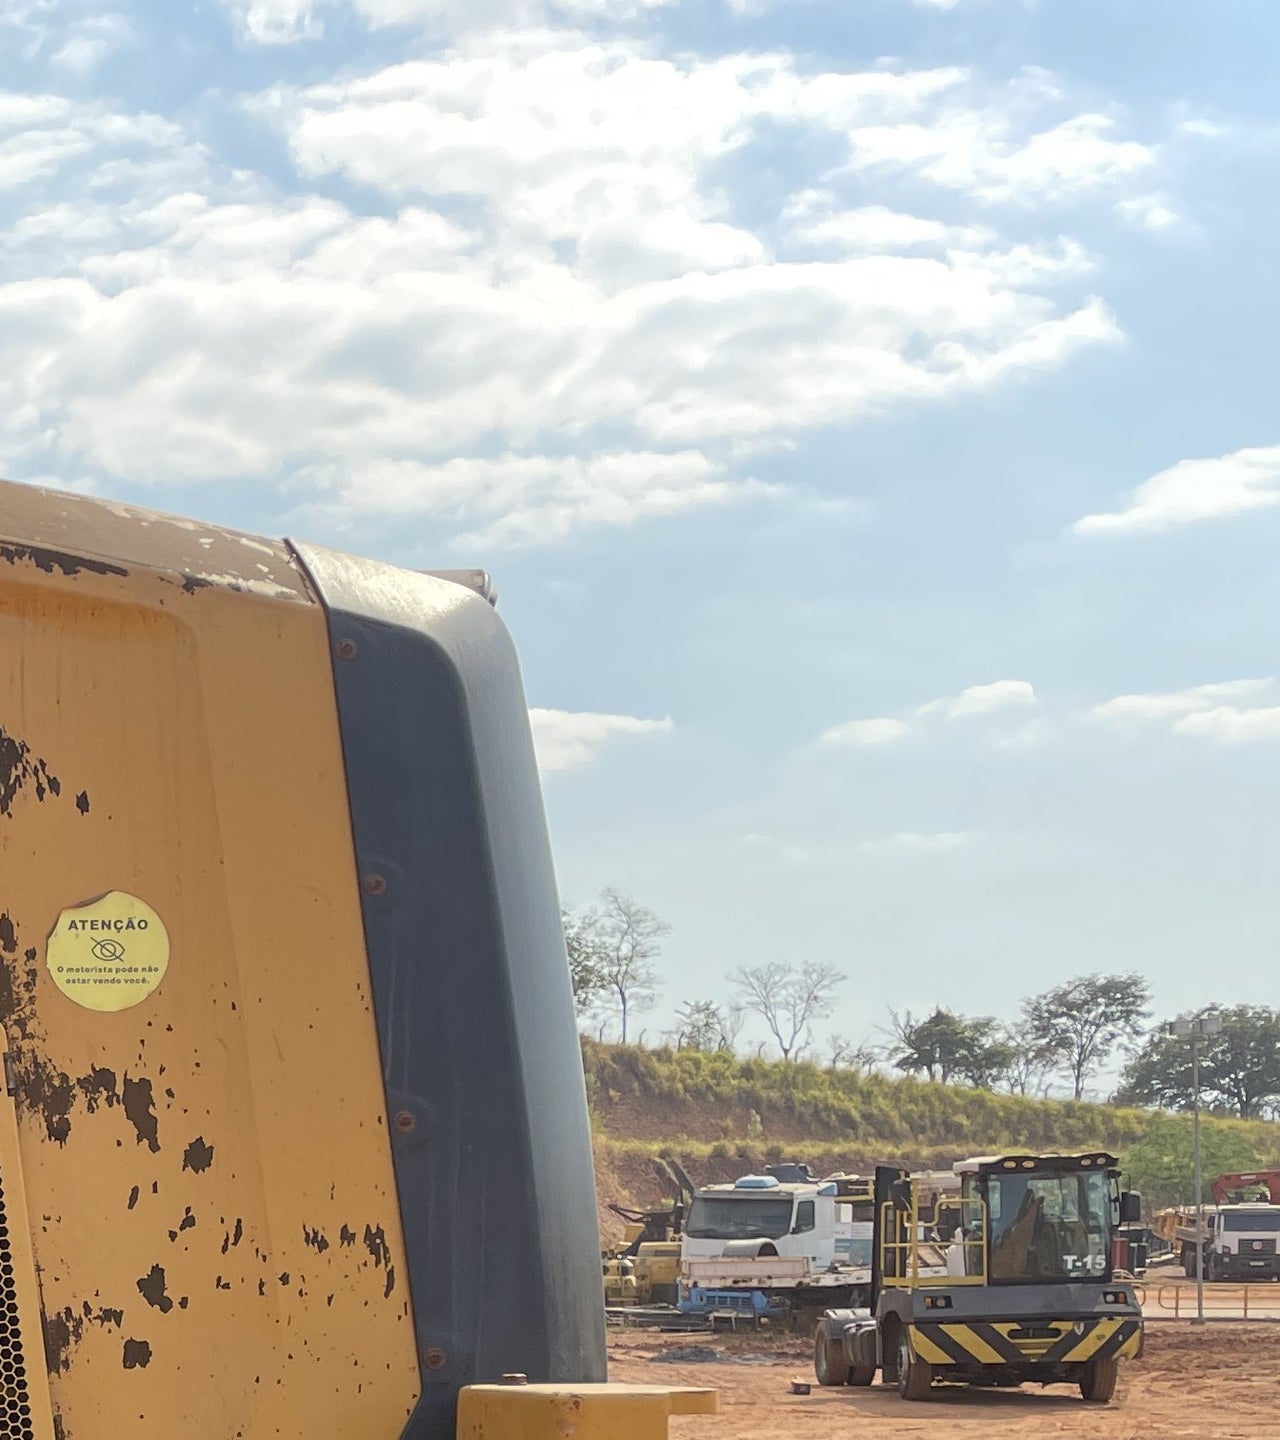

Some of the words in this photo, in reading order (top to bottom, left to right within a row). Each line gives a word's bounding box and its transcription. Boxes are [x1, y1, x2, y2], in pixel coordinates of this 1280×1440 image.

[68, 917, 149, 933] ATENÇÃO
[115, 965, 139, 975] pode
[141, 965, 159, 973] não
[93, 976, 122, 985] vendo
[1062, 1254, 1107, 1270] T-15
